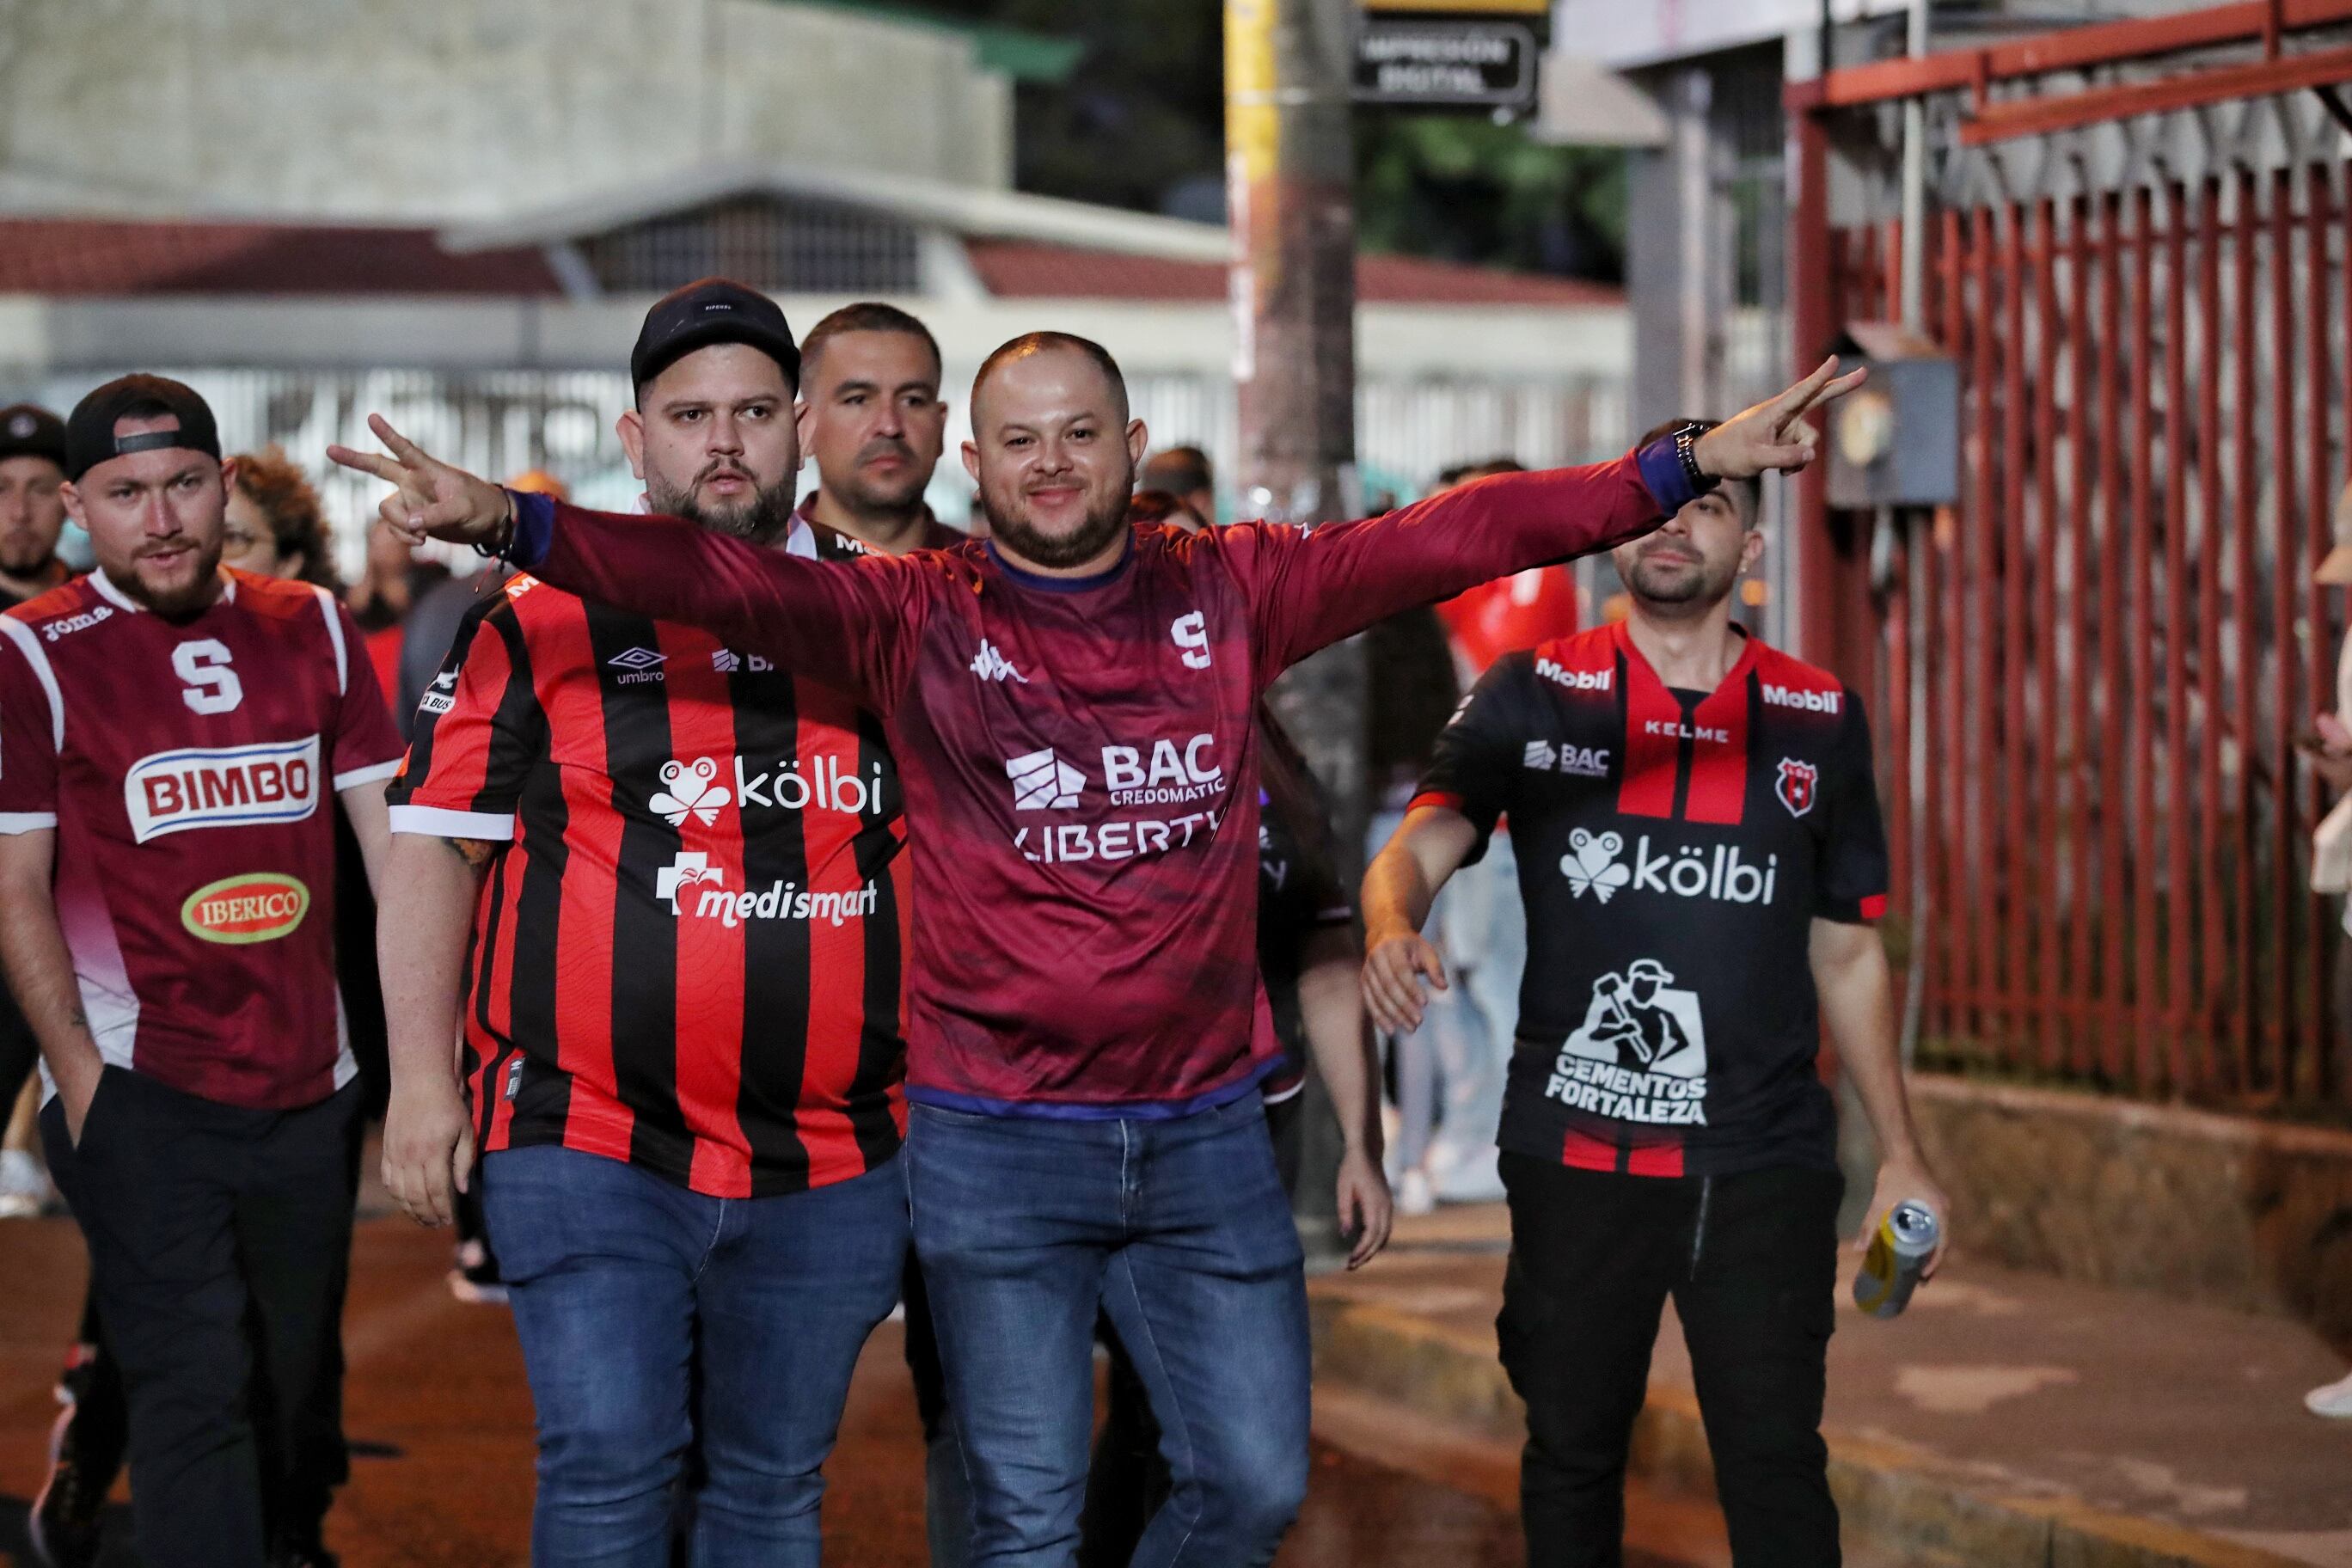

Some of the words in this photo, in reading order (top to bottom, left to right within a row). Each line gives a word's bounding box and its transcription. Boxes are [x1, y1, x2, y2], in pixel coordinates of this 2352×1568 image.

[171, 638, 243, 715] S
[617, 671, 665, 684] umbro
[1535, 657, 1610, 691] Mobil
[430, 697, 451, 710] BUS
[1762, 683, 1838, 714] Mobil
[1645, 720, 1729, 744] KELME
[1101, 733, 1222, 792] BAC
[1560, 743, 1610, 770] BAC
[143, 758, 309, 818] BIMBO
[734, 755, 882, 815] kölbi
[1110, 777, 1226, 807] CREDOMATIC
[1633, 835, 1777, 905] kölbi
[200, 891, 300, 927] IBERICO
[696, 879, 877, 928] medismart
[1556, 1054, 1707, 1100] CEMENTOS
[1545, 1074, 1708, 1127] FORTALEZA
